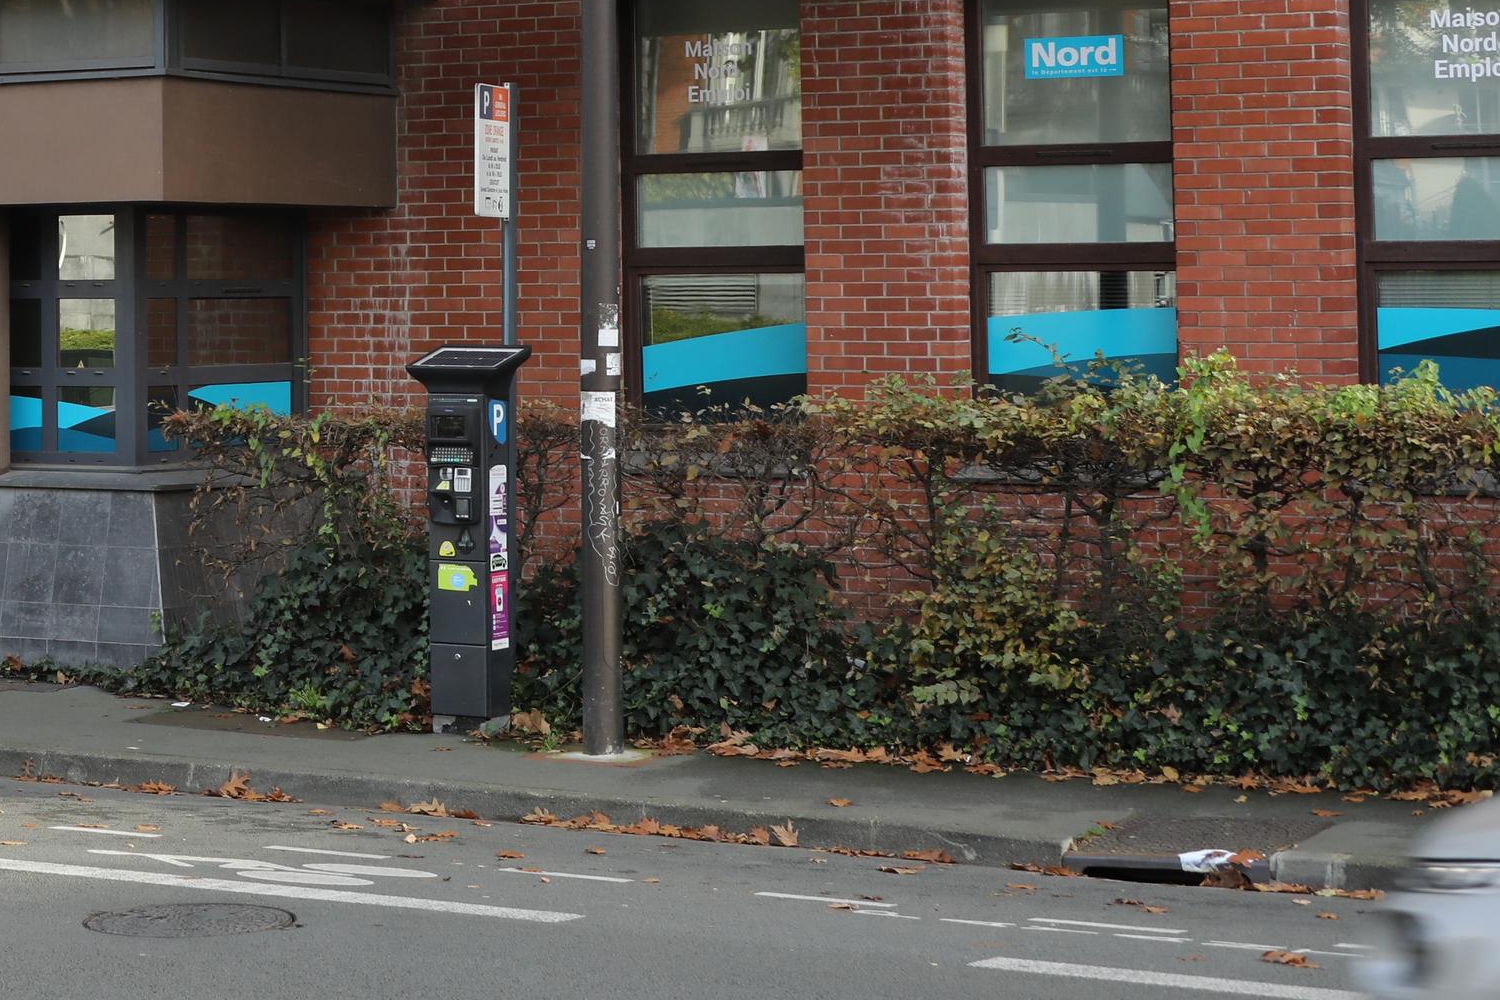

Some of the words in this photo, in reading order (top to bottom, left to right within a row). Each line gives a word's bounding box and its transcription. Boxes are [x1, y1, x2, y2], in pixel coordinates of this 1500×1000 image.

[1430, 7, 1500, 29] Maiso
[685, 39, 752, 57] Maison
[1031, 38, 1116, 68] Nord
[1442, 31, 1497, 53] Nord
[1434, 57, 1500, 82] Emplo
[688, 82, 750, 105] Emploi
[493, 404, 503, 436] P
